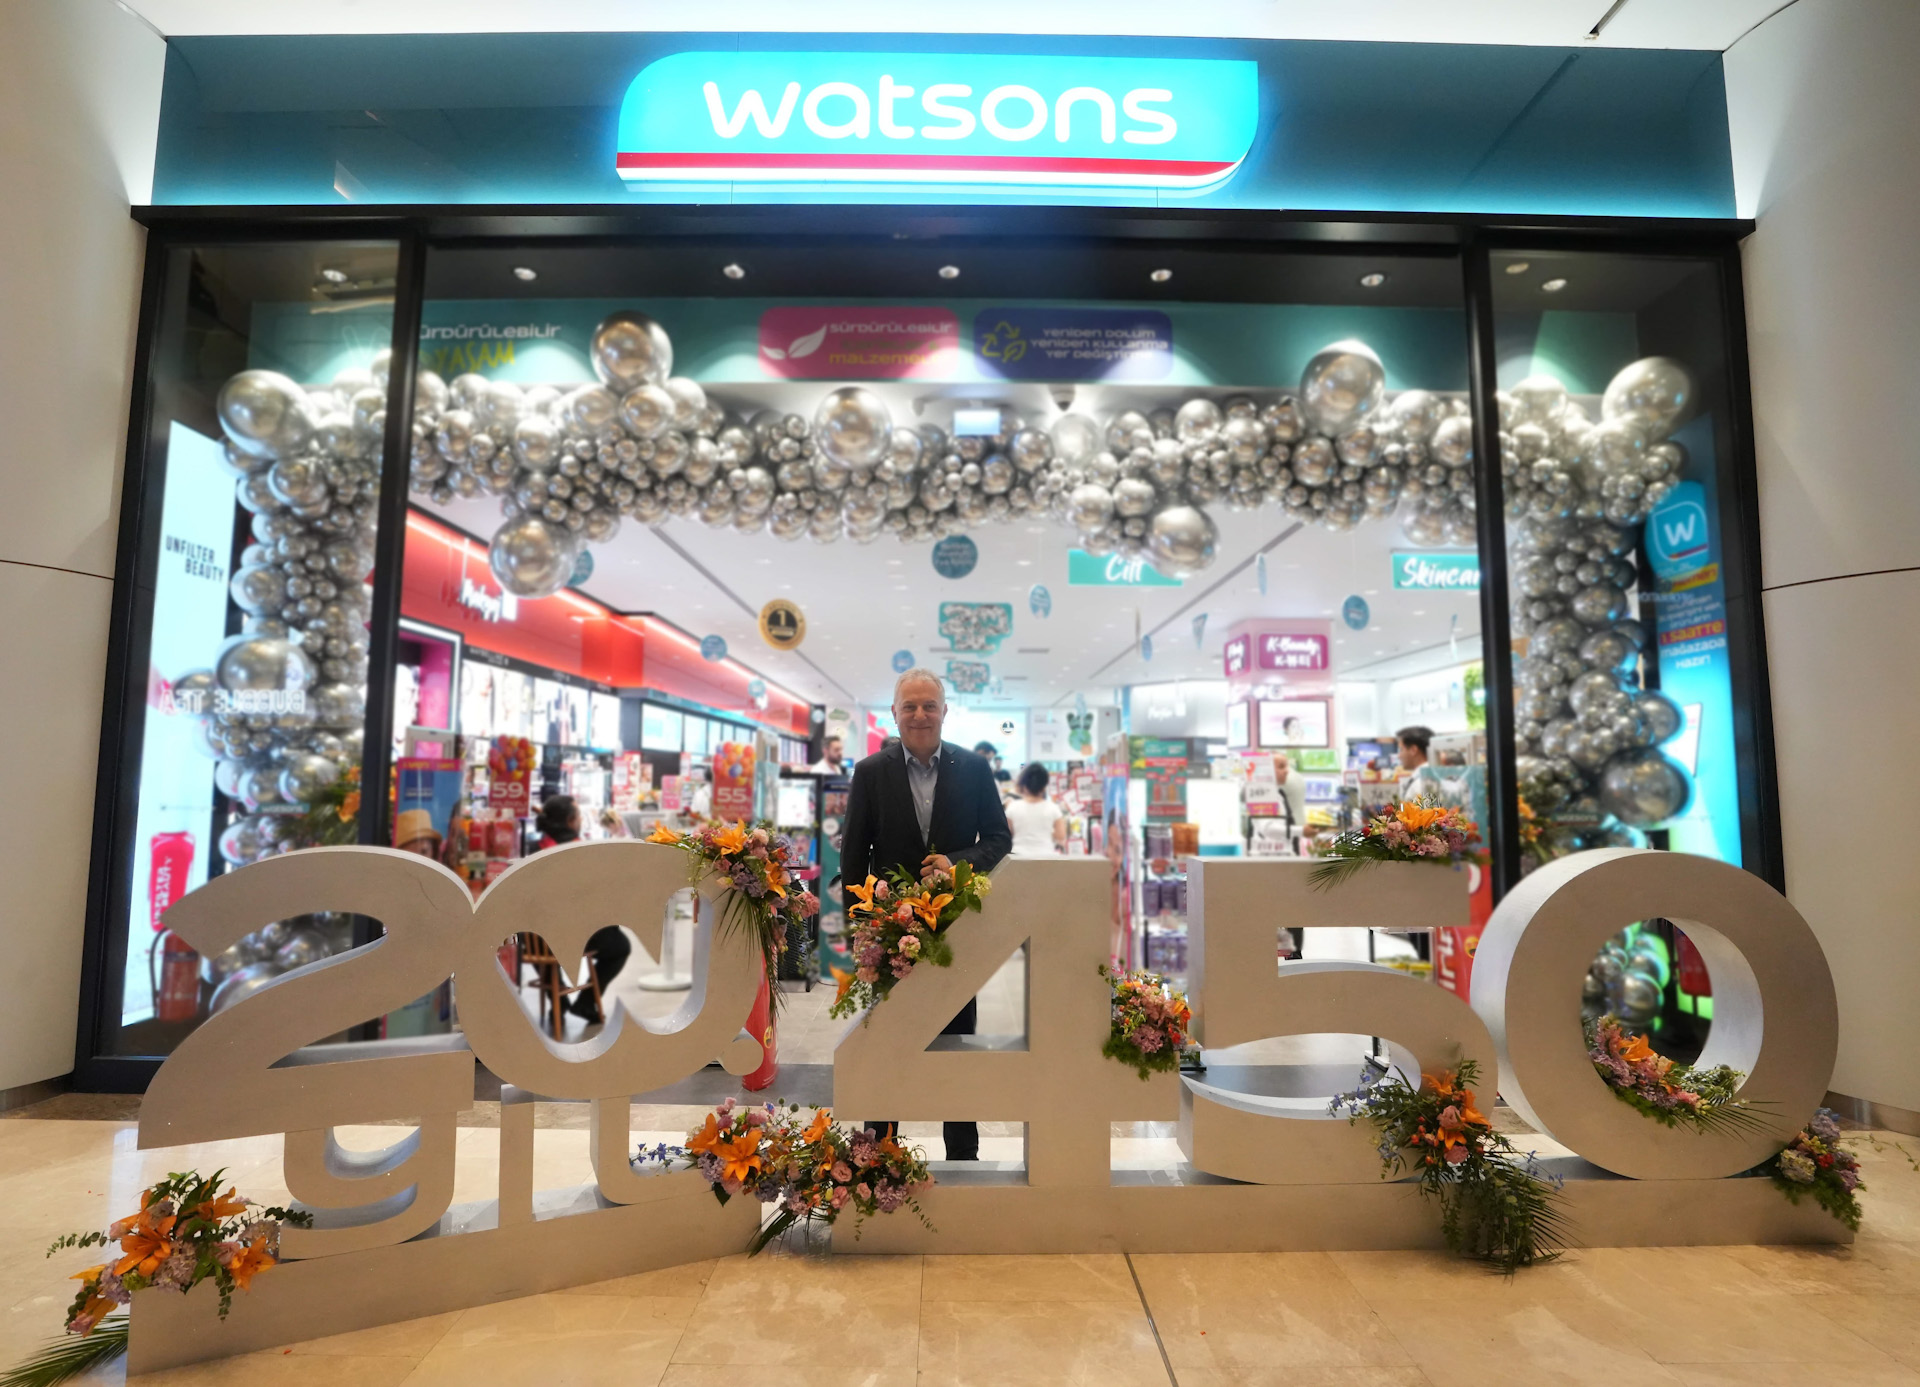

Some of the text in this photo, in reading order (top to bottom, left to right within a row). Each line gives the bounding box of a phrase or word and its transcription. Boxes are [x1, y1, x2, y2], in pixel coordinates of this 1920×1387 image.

[703, 74, 1178, 145] watsons
[420, 323, 561, 339] ürdürülebilir
[165, 534, 216, 565] UNFILTER
[184, 558, 225, 583] BEAUTY
[1400, 557, 1480, 587] Skincar
[716, 787, 748, 804] 55
[833, 849, 1840, 1187] 450
